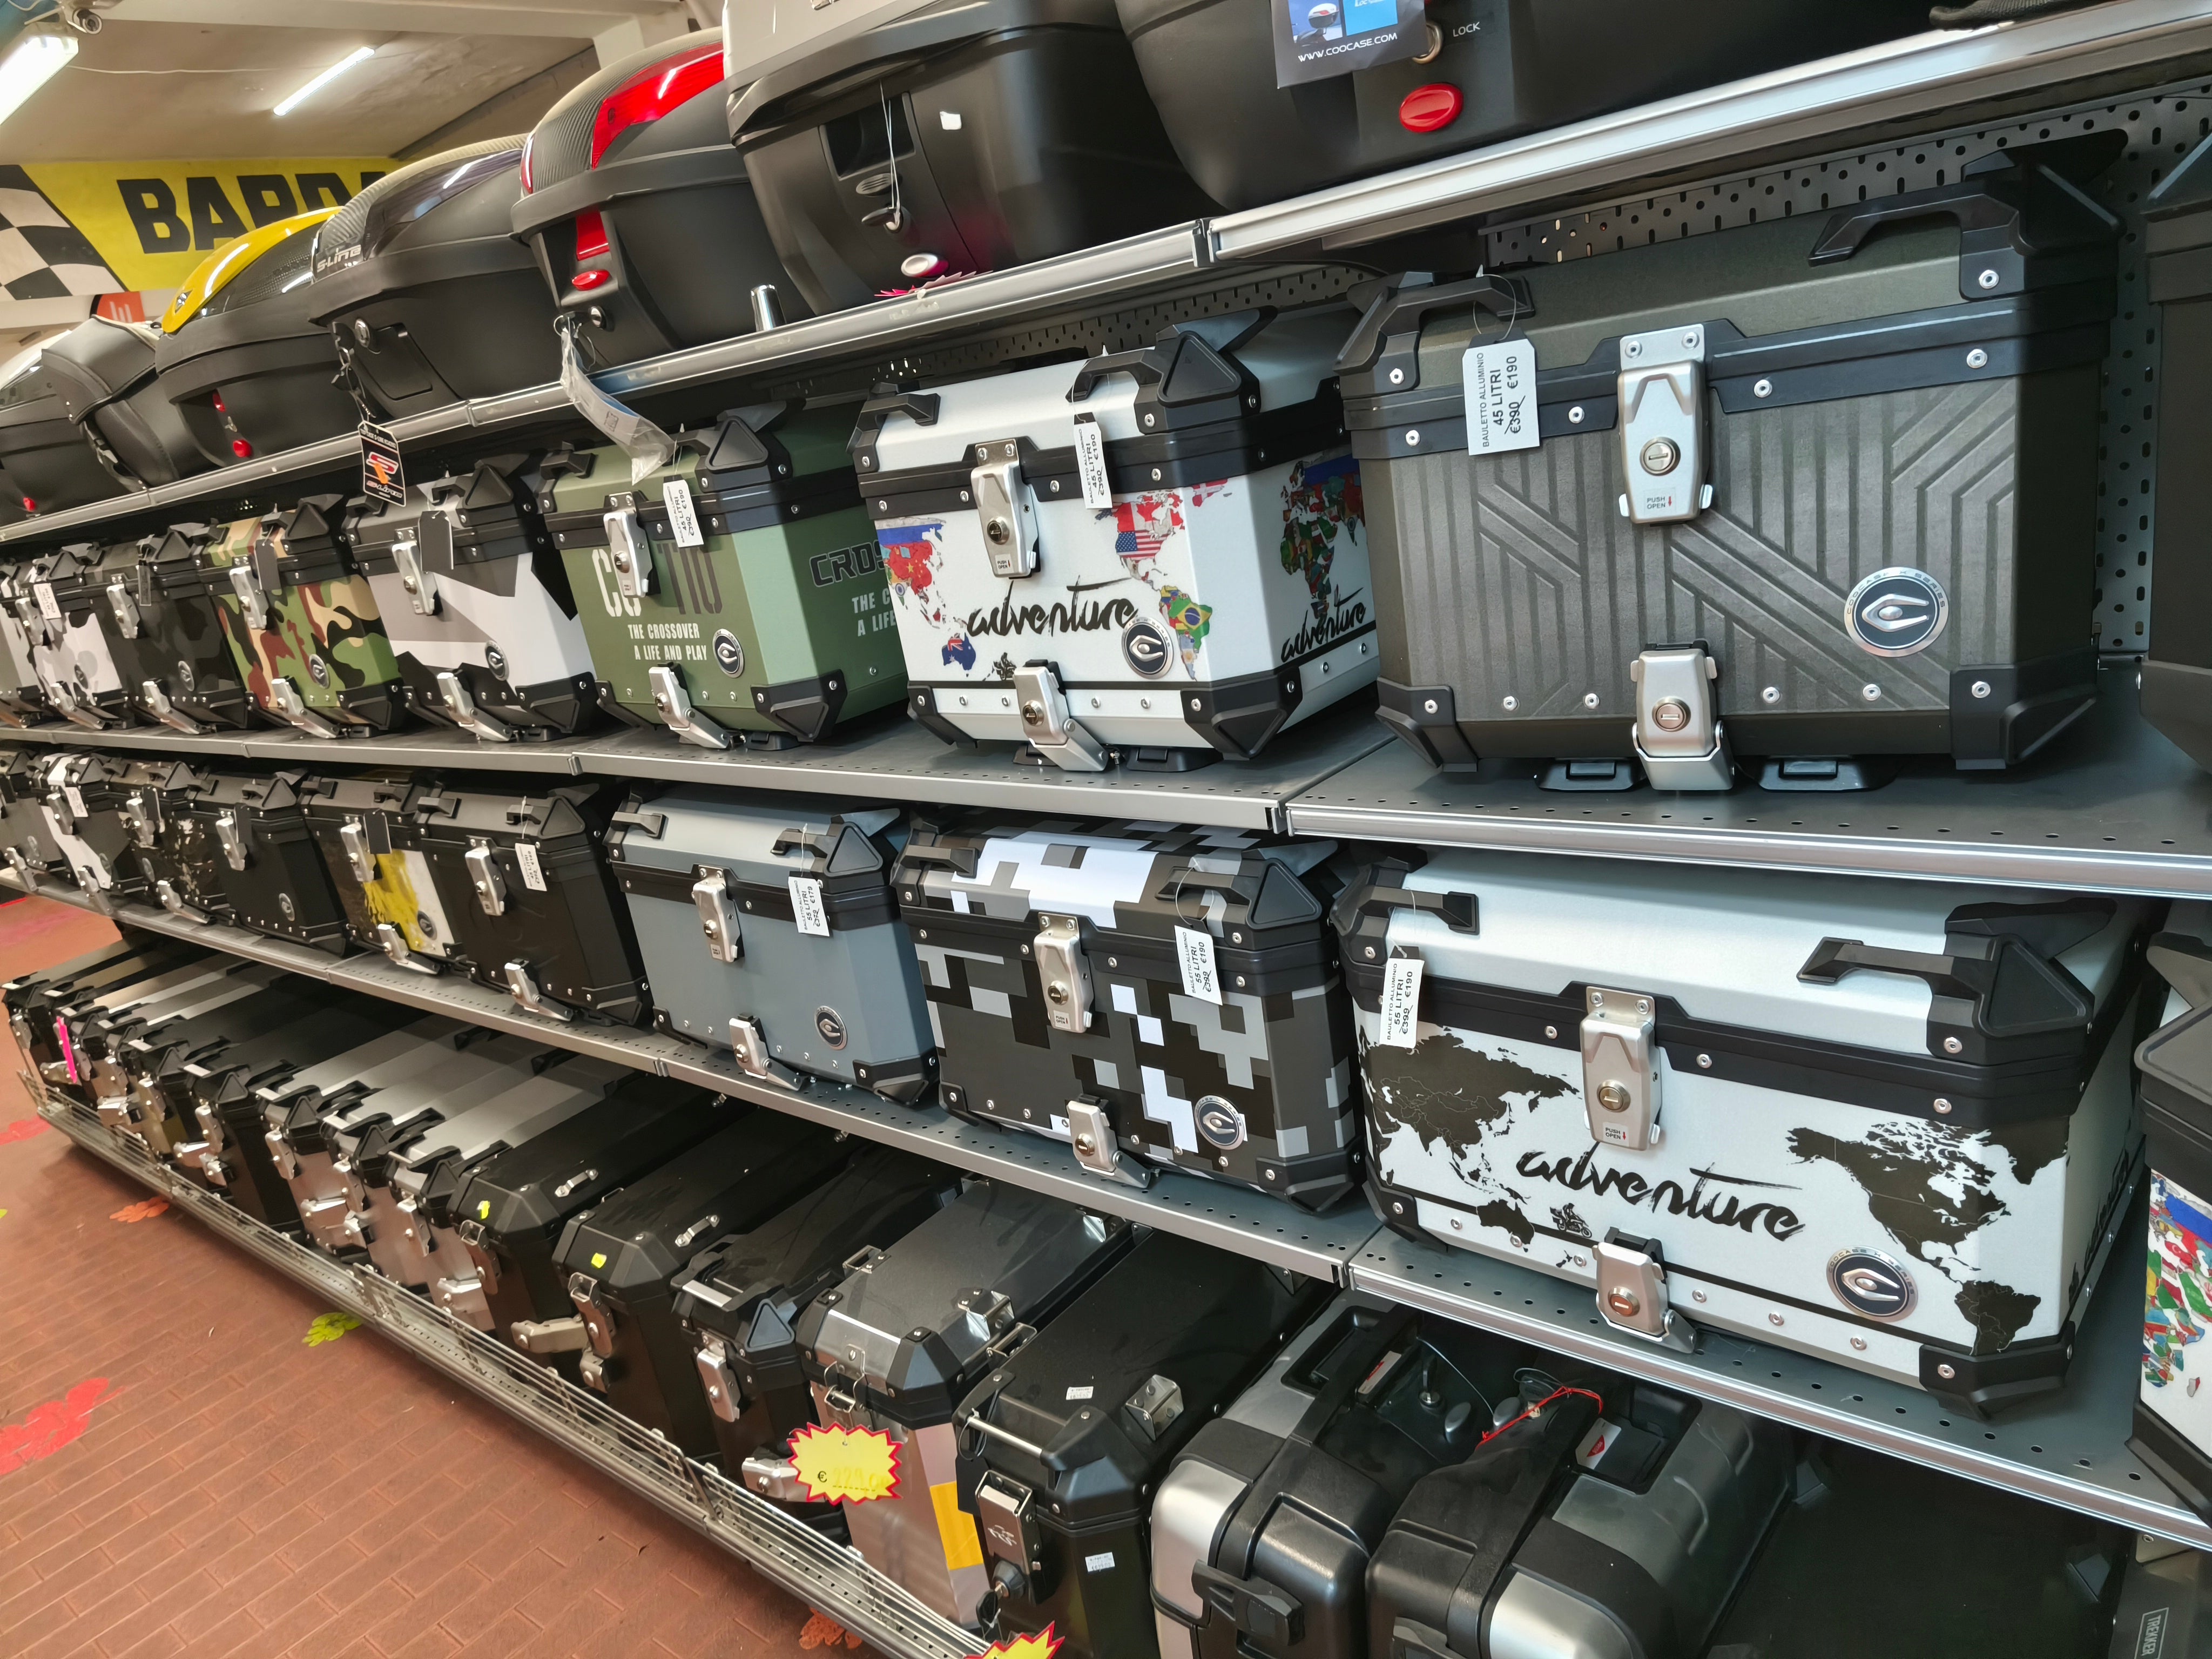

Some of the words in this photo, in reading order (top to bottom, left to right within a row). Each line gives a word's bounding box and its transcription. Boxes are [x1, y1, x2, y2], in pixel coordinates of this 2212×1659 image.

[1453, 22, 1481, 37] LOCK
[1298, 33, 1397, 62] WWW.COOCASE.COM
[1476, 353, 1486, 399] ALLUMINIO
[1506, 356, 1518, 388] €190
[1490, 369, 1502, 406] LITRI
[1480, 402, 1489, 447] BAULETTO
[1493, 410, 1503, 426] 45
[1086, 443, 1094, 473] LITRI
[1091, 475, 1097, 488] 45
[675, 496, 683, 518] LITRI
[1914, 572, 1945, 608] SERIES
[852, 592, 875, 614] THE
[967, 575, 1139, 637] adventure
[628, 624, 644, 639] THE
[648, 623, 700, 639] CROSSOVER
[858, 619, 866, 637] A
[872, 610, 896, 632] LIFE
[1281, 583, 1366, 663] adventure
[634, 645, 640, 660] A
[643, 645, 660, 660] LIFE
[664, 645, 682, 660] AND
[686, 645, 707, 660] PLAY
[801, 891, 810, 910] LITRI
[807, 886, 815, 903] €179
[1190, 946, 1200, 970] LITRI
[1198, 942, 1207, 963] €190
[1195, 973, 1202, 983] 55
[1395, 979, 1404, 1008] LITRI
[1394, 1012, 1400, 1025] 55
[1516, 1141, 1806, 1242] adventure
[2141, 1614, 2161, 1656] TREKKER
